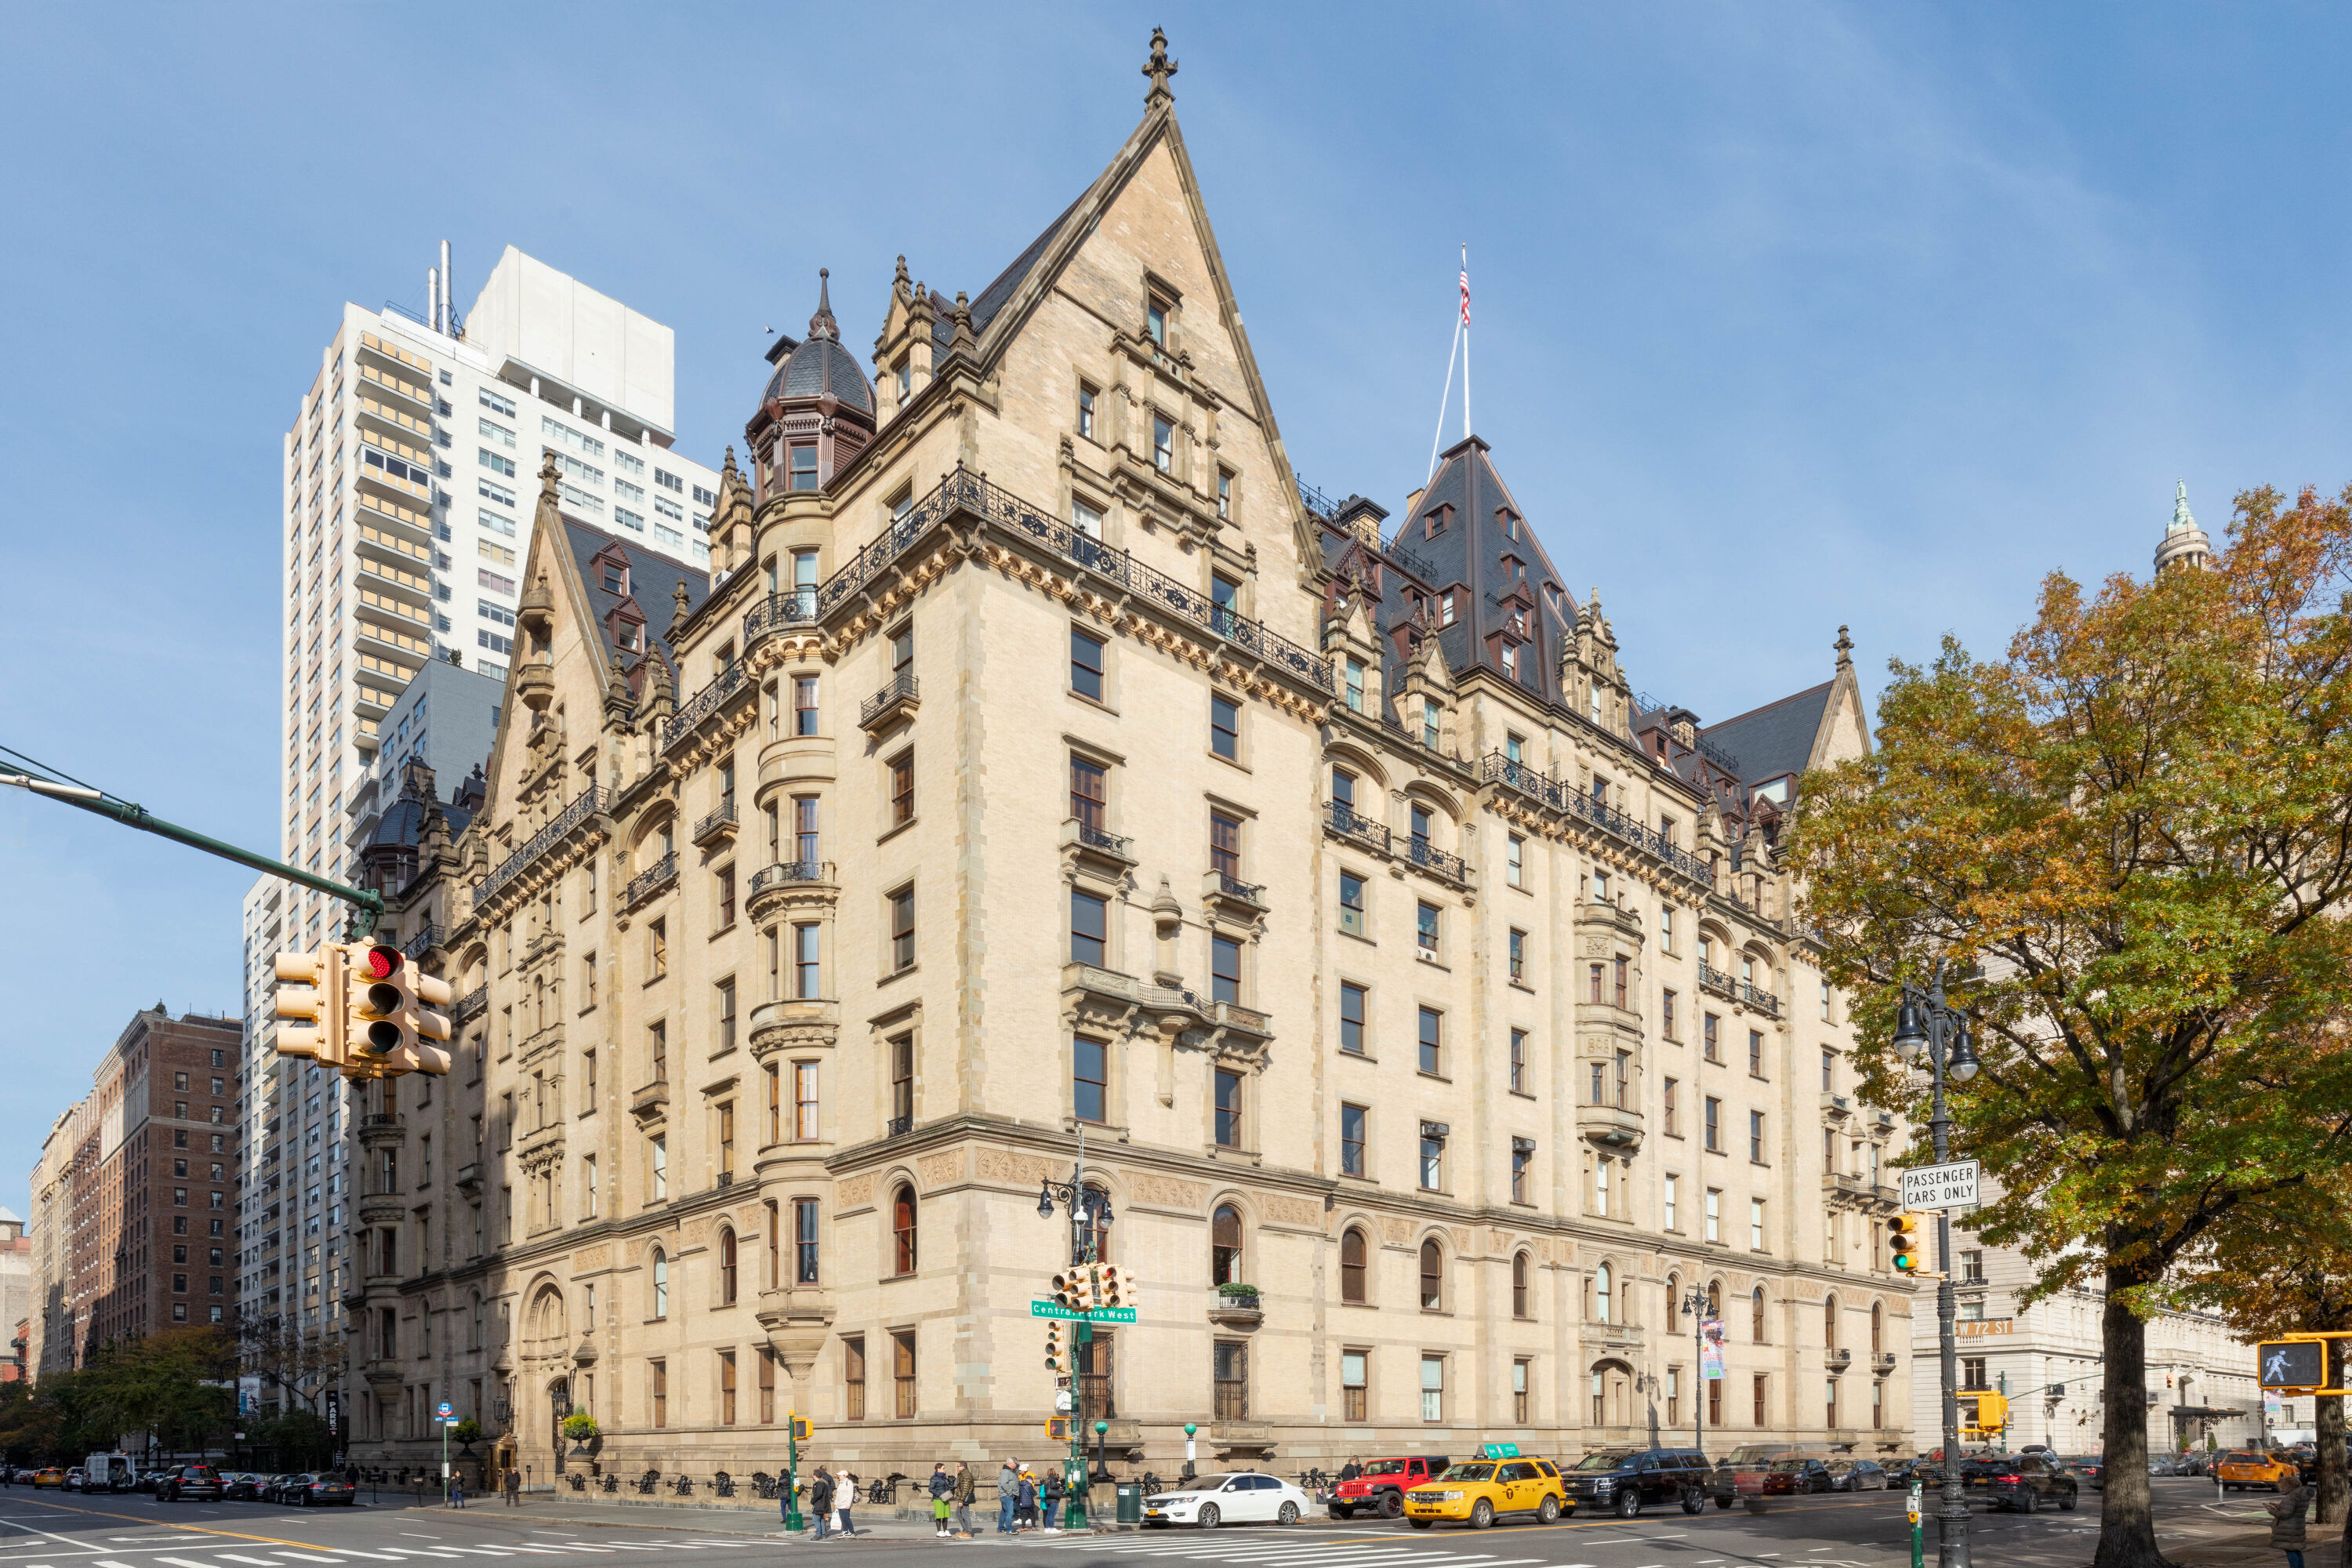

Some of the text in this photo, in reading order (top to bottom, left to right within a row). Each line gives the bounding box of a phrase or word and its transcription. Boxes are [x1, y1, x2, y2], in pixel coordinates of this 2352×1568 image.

[1907, 1167, 1973, 1188] PASSENGER
[1907, 1185, 1973, 1204] CARS ONLY
[1108, 1310, 1134, 1319] West
[1959, 1321, 2009, 1335] W 72 ST
